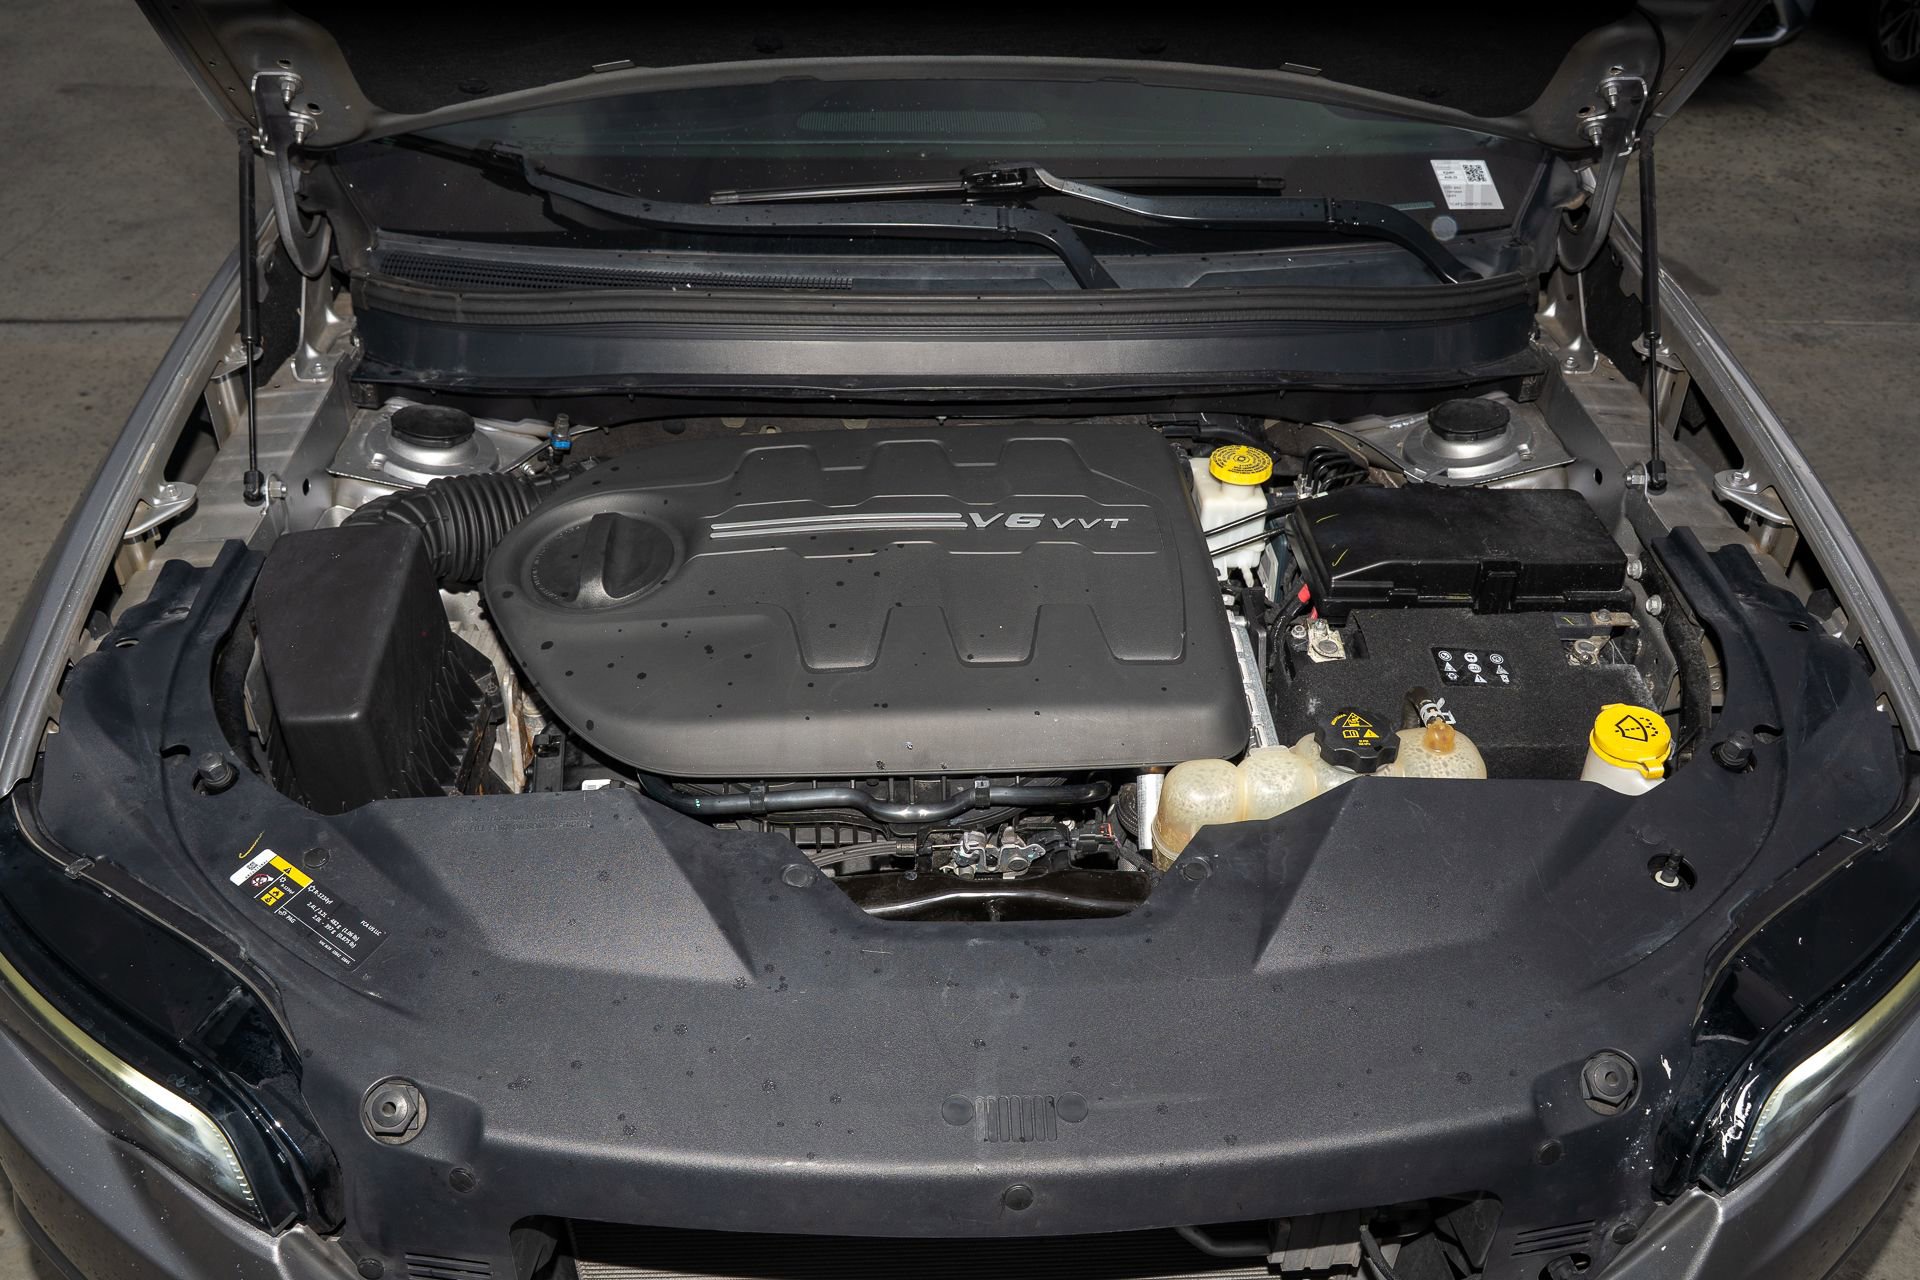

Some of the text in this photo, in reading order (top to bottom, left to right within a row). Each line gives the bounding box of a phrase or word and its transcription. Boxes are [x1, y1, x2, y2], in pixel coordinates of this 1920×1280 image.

[968, 512, 1129, 529] V6 VVT
[286, 915, 297, 924] PAG
[360, 920, 370, 928] FCA
[373, 928, 382, 936] LLC
